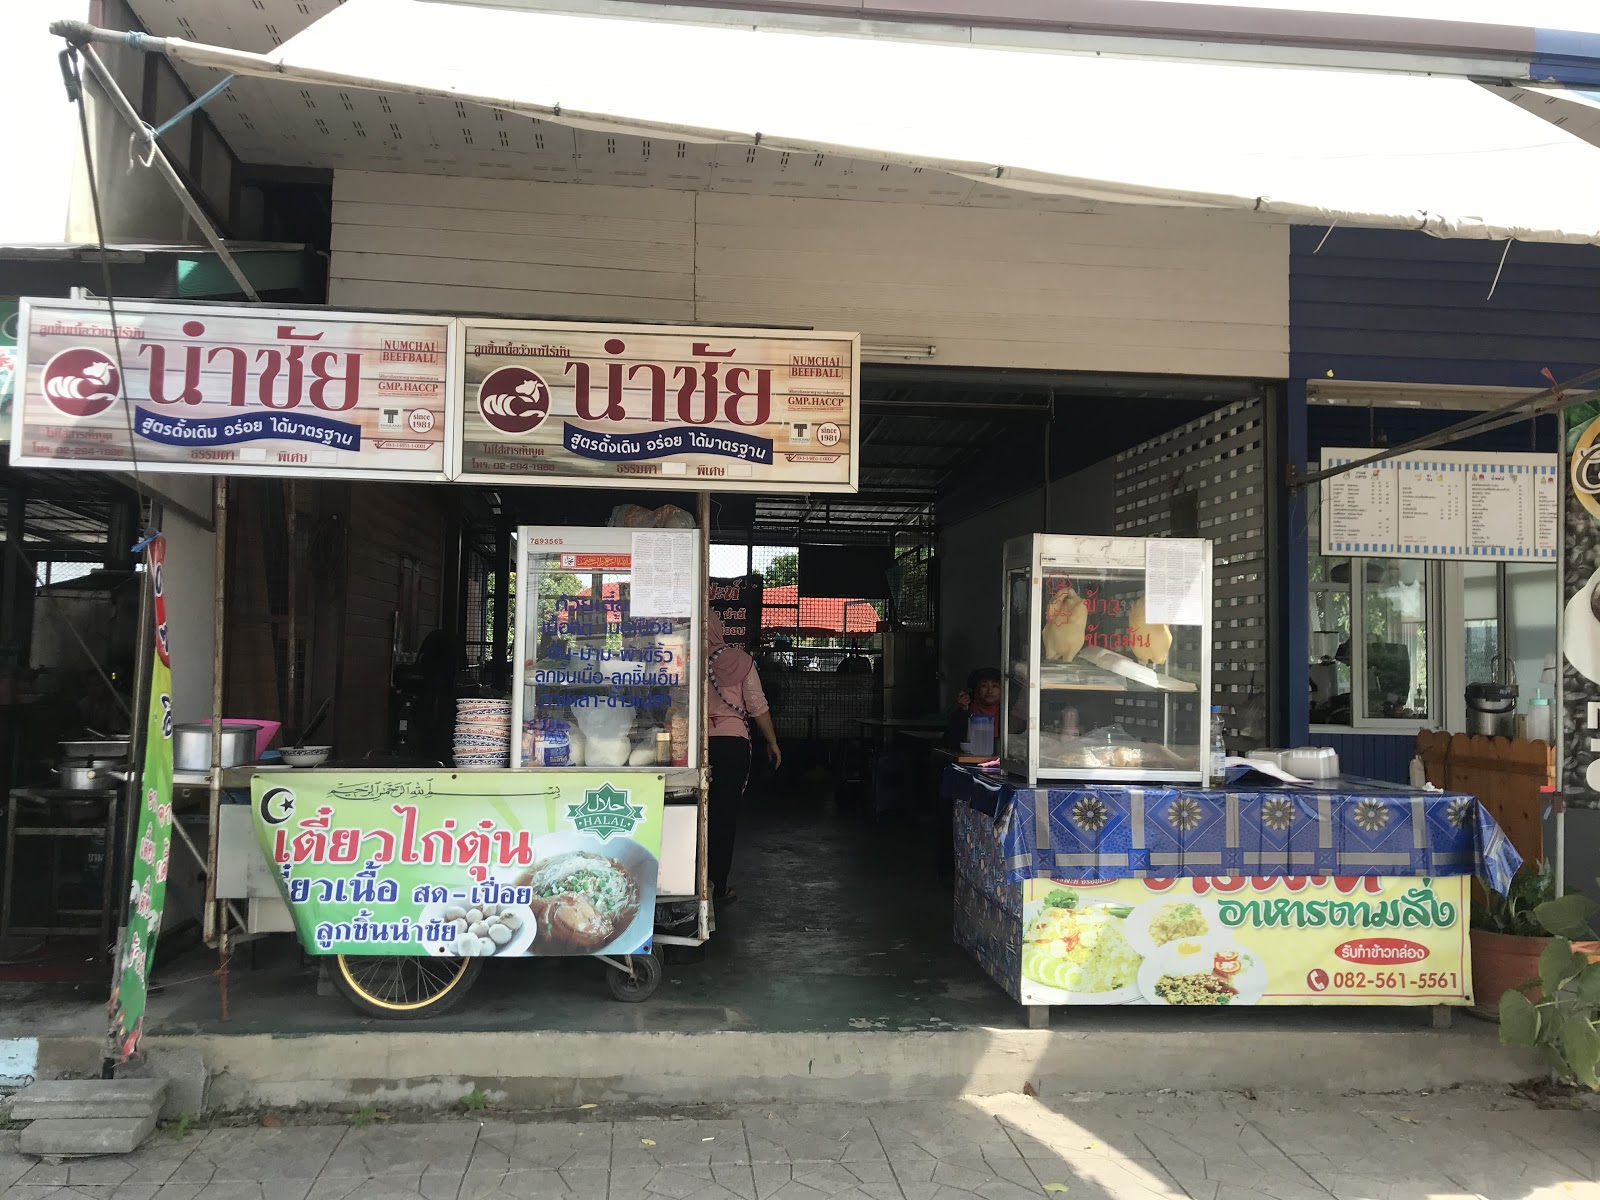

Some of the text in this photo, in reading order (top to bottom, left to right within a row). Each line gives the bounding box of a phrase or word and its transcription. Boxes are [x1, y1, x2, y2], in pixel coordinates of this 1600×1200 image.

[383, 339, 436, 352] NUMCHAI
[382, 351, 437, 364] BEEFBALL
[792, 355, 841, 367] NUMCHAI
[137, 320, 365, 413] นำชัย
[791, 366, 842, 378] BEEFBALL
[563, 338, 775, 428] นำชัย
[413, 412, 431, 421] since
[141, 416, 354, 446] สูตรดั้งเดิม อร่อย ได้มาตรฐาน
[412, 420, 431, 429] 1981
[820, 426, 837, 434] since
[820, 434, 838, 442] 1981
[570, 432, 767, 460] สูตรดั้งเดิม อร่อย ได้มาตรฐาน
[191, 448, 235, 461] ธรรมดา
[277, 450, 308, 463] พิเศษ
[616, 463, 658, 475] ธรรมดา
[696, 464, 725, 477] พิเศษ
[530, 537, 564, 545] 7893565
[1083, 585, 1121, 616] ข้าว
[1085, 621, 1151, 651] ข้าวมัน
[587, 793, 626, 813] حلال
[583, 815, 628, 828] HALAL
[273, 804, 533, 881] เตี๋ยวไก่ตุ๋น
[1218, 877, 1457, 930] อาหารตามสั่ง
[315, 909, 457, 948] ลูกชิ้นนำชัย
[1340, 940, 1427, 962] รับทำข้าวกล่อง
[1333, 971, 1459, 990] 082-561-5561
